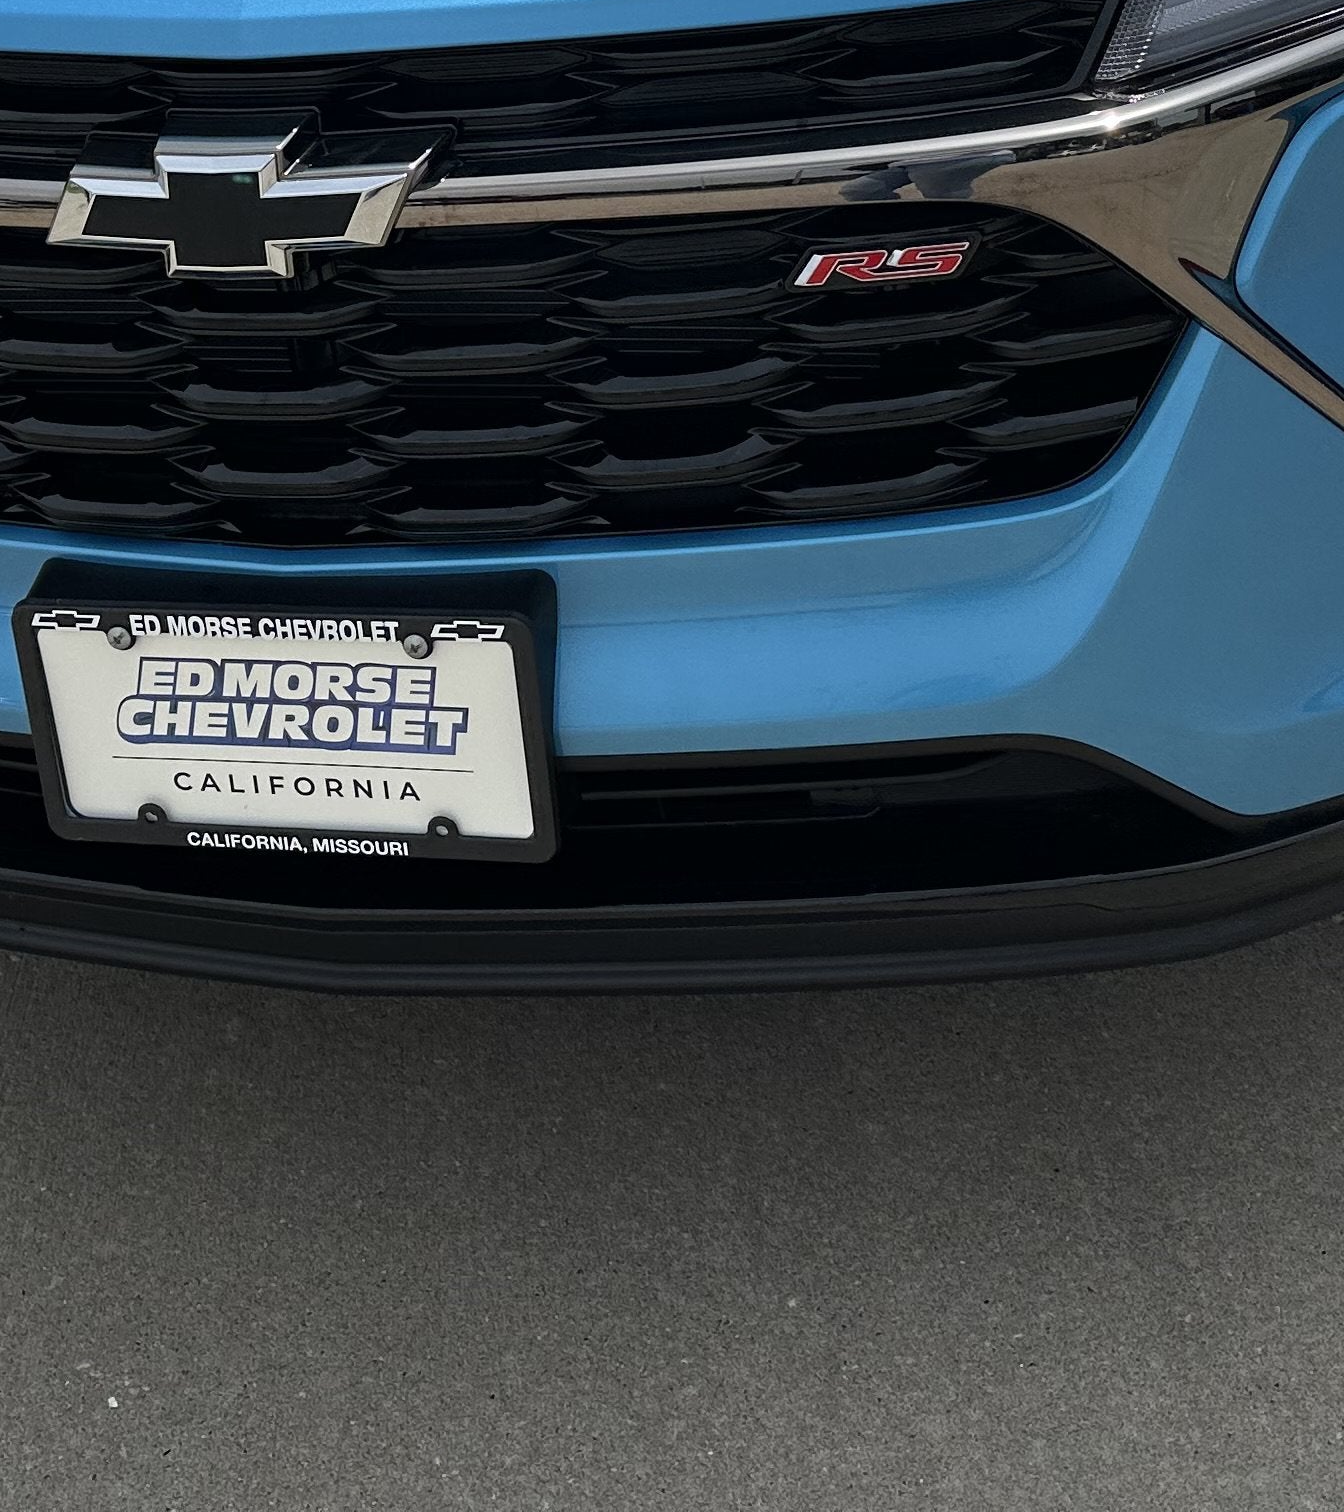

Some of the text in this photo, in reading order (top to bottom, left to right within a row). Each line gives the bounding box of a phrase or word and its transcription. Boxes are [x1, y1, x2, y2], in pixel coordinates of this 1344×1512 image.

[794, 242, 970, 286] RS
[129, 614, 399, 643] ED MORSE CHEVROLET
[117, 657, 467, 752] ED MORSE CHEVROLET
[173, 772, 421, 801] CALIFORNIA
[187, 831, 410, 856] CALIFORNIA, MISSOURI
